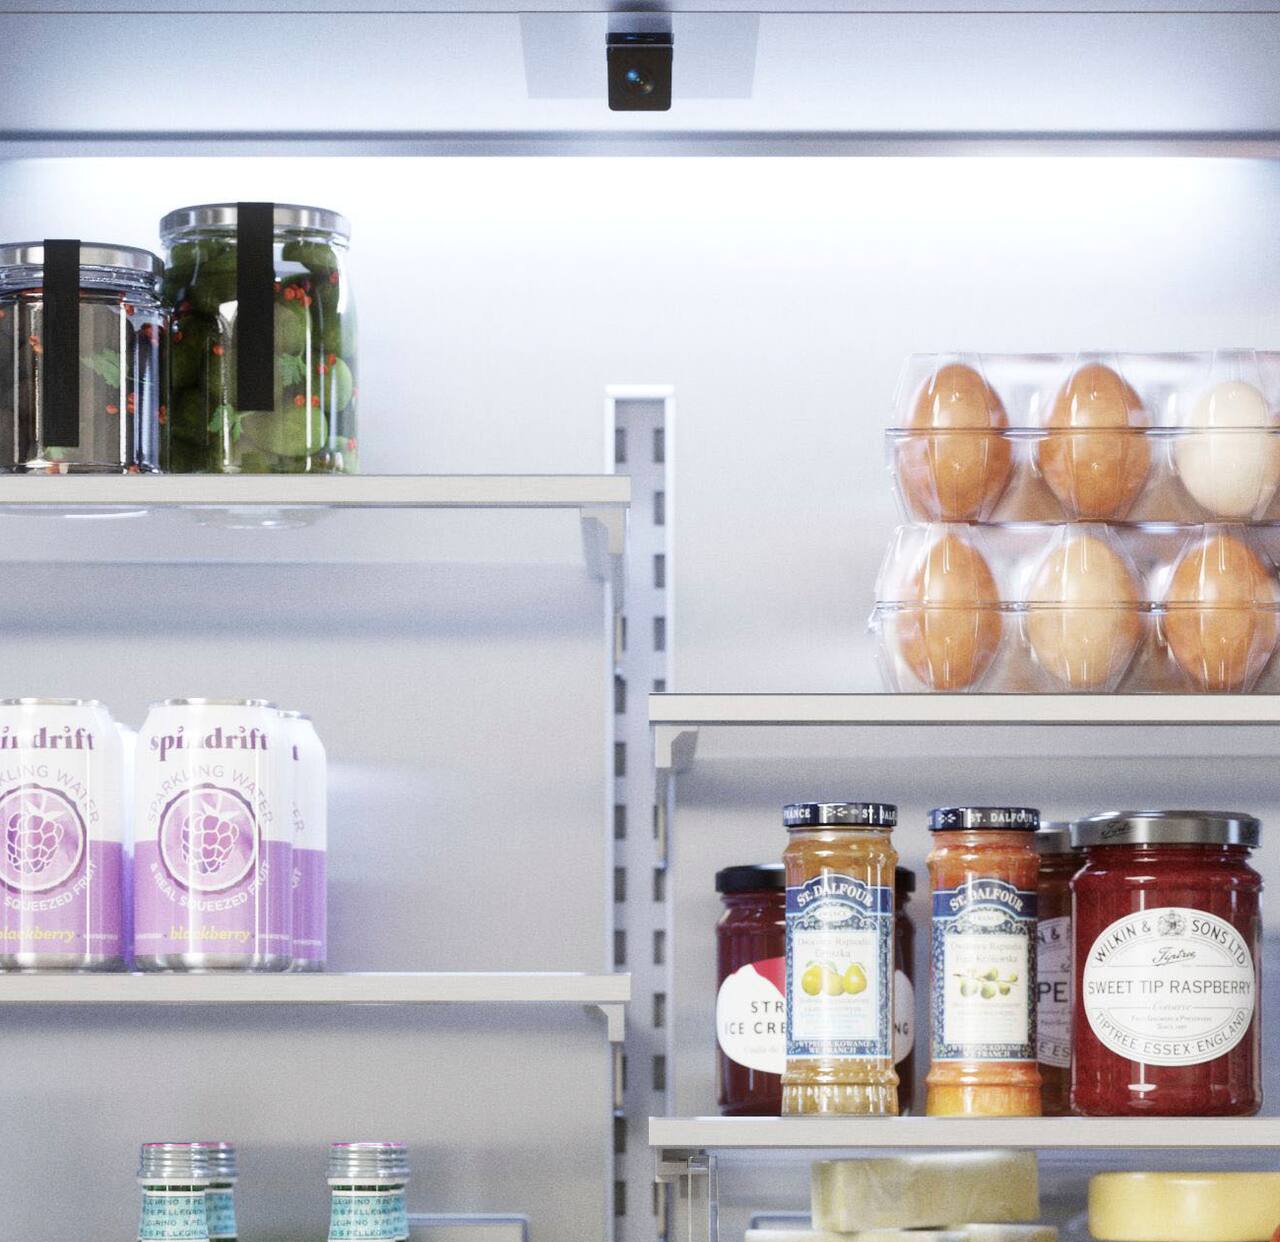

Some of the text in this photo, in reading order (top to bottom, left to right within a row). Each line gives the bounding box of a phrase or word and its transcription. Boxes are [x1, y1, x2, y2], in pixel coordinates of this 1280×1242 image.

[149, 726, 268, 762] spidrift
[4, 891, 73, 912] SQUEEZED
[154, 873, 176, 902] REAL
[179, 892, 249, 913] SUEEZED
[812, 881, 875, 906] DALFOUR
[966, 886, 1023, 911] DALFOUR
[170, 924, 250, 943] blkberry
[1095, 923, 1136, 962] WILKIN
[1142, 921, 1151, 932] &
[1192, 919, 1227, 945] SONS
[1227, 935, 1246, 966] LTD
[1087, 980, 1252, 995] SWEET TIP RASPBERRY
[725, 1022, 744, 1035] ICE
[1095, 1012, 1138, 1050] TIPTREE
[1143, 1042, 1191, 1055] ESSEX
[1197, 1010, 1246, 1053] ENGLAND
